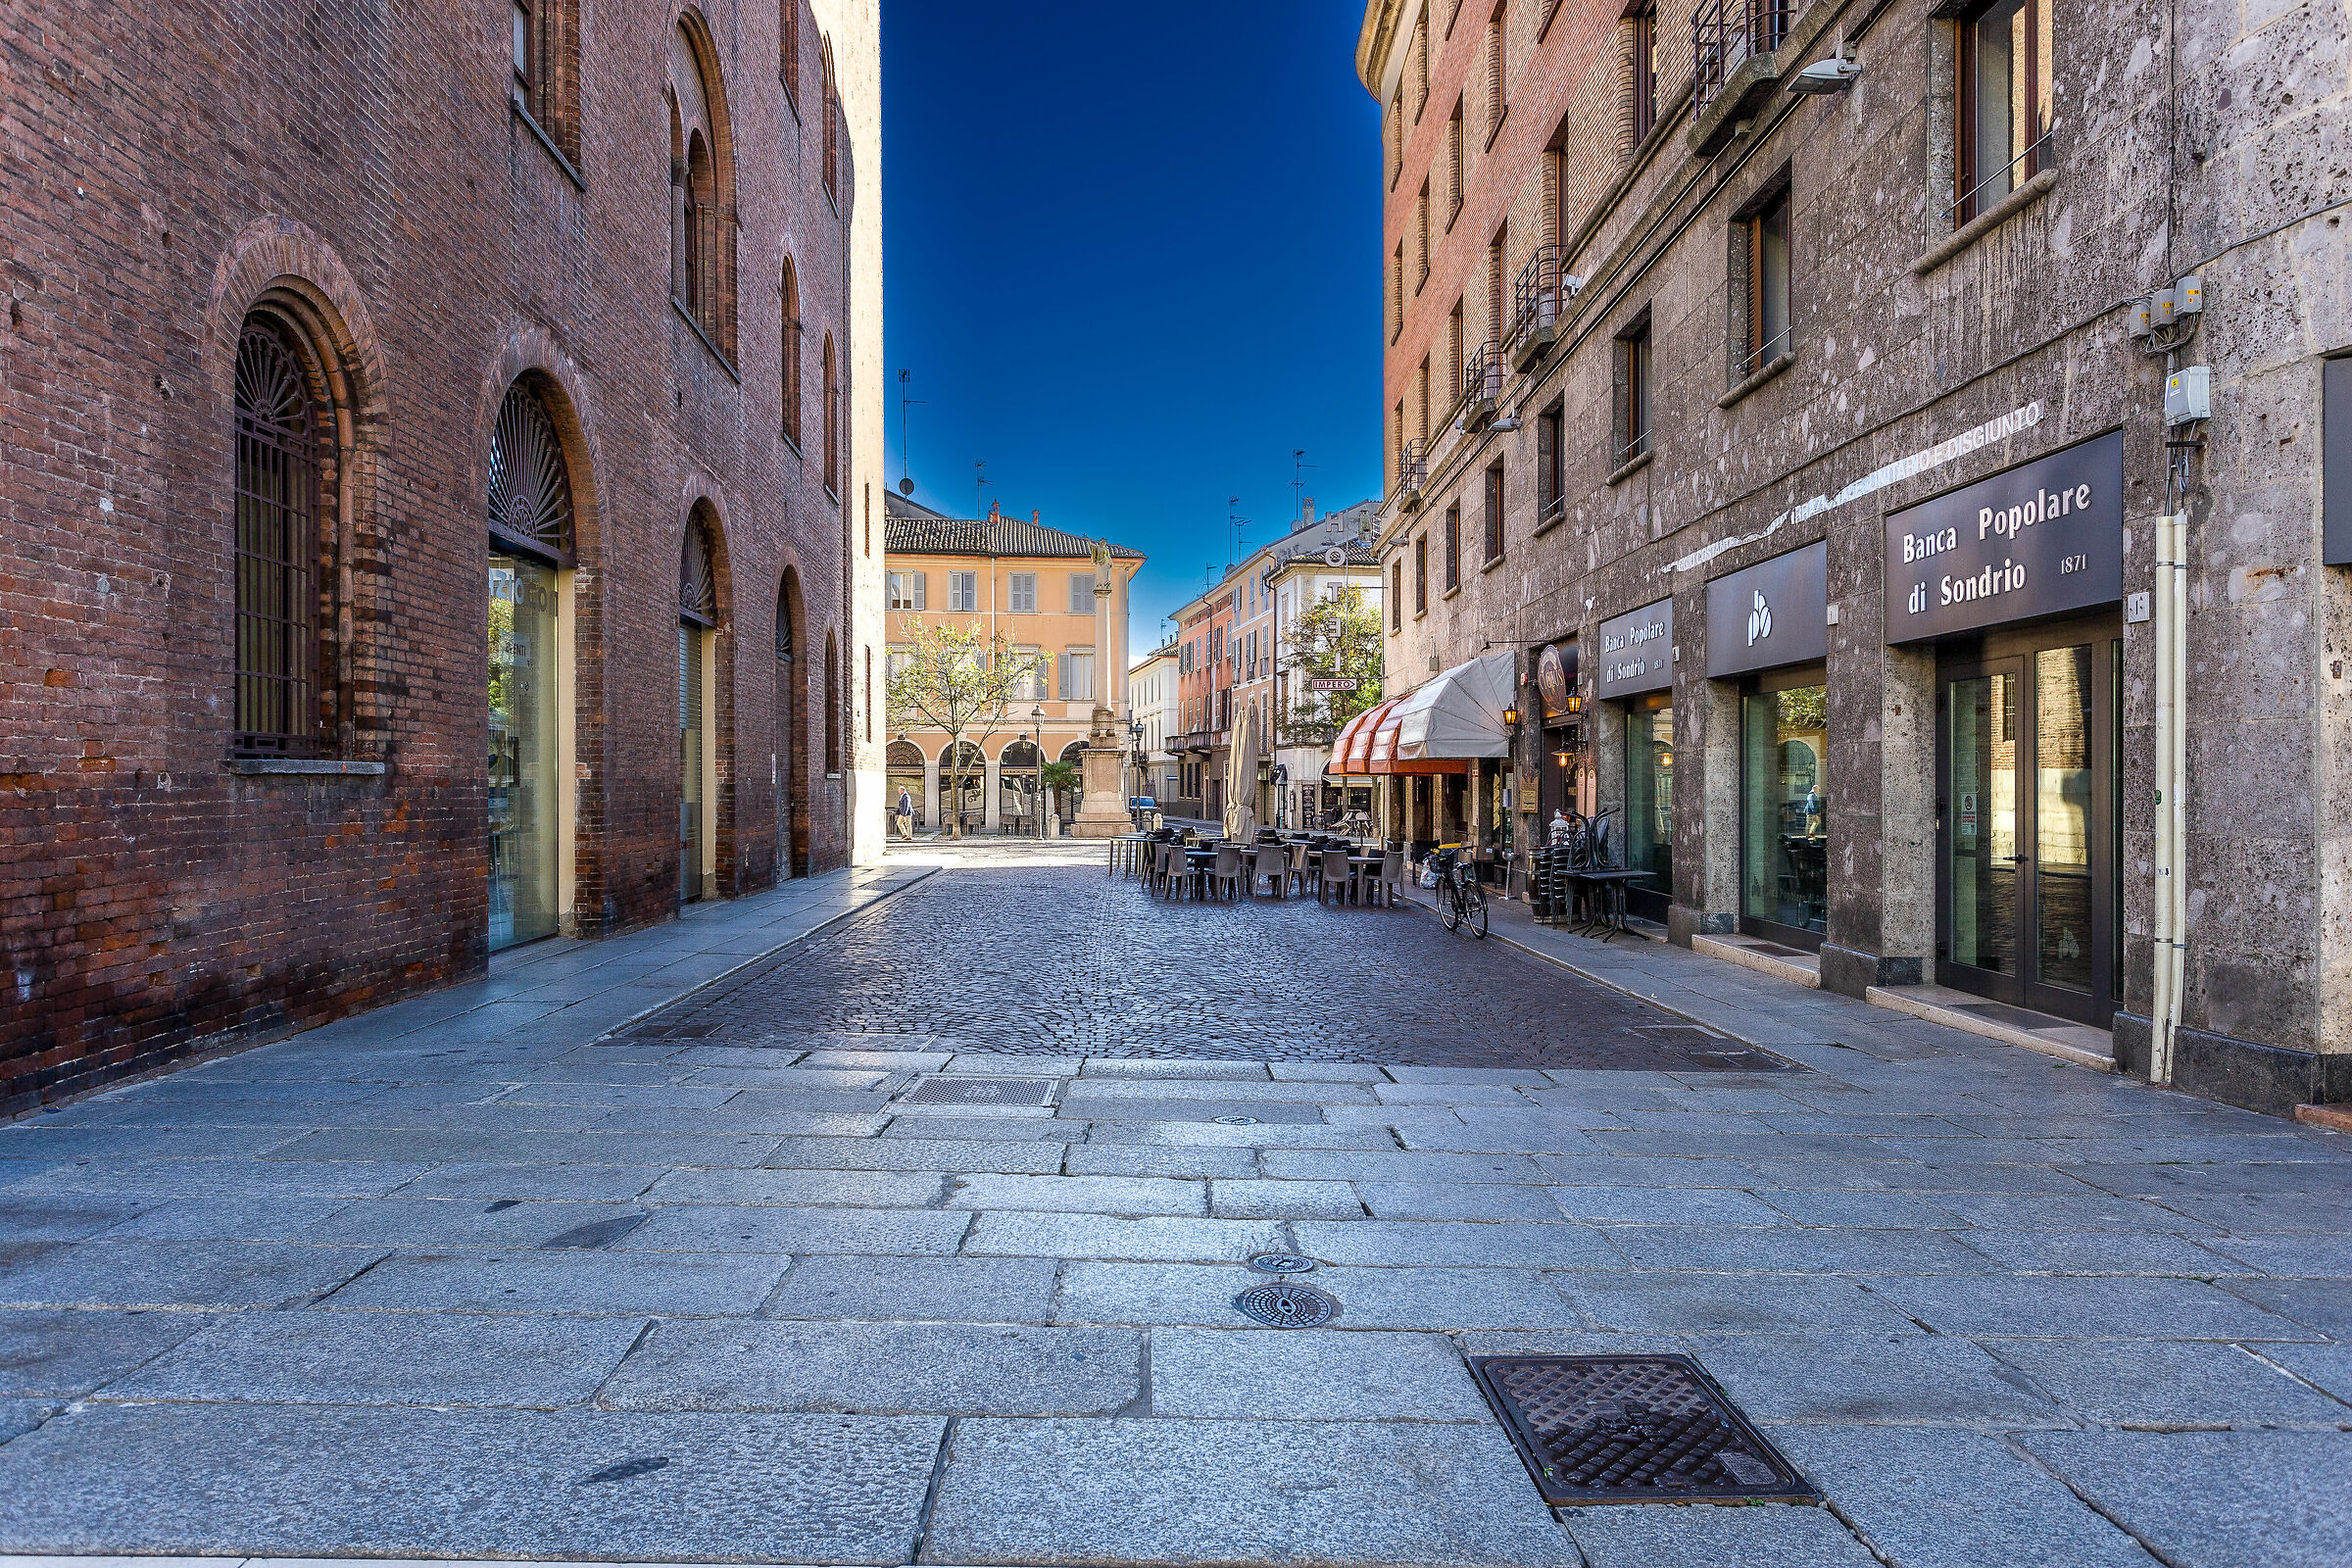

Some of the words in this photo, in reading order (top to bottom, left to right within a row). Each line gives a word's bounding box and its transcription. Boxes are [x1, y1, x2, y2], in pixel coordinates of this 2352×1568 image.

[1902, 522, 1958, 564] Banca
[1978, 481, 2092, 542] Popolare
[2060, 554, 2088, 575] 1871
[1908, 581, 1927, 614] di
[1939, 557, 2028, 608] Sondrio
[1605, 634, 1625, 654] Banca
[1630, 620, 1664, 647] Popolare
[1314, 680, 1349, 689] IMPERO
[1606, 663, 1615, 683] di
[1618, 656, 1645, 680] Sondrio
